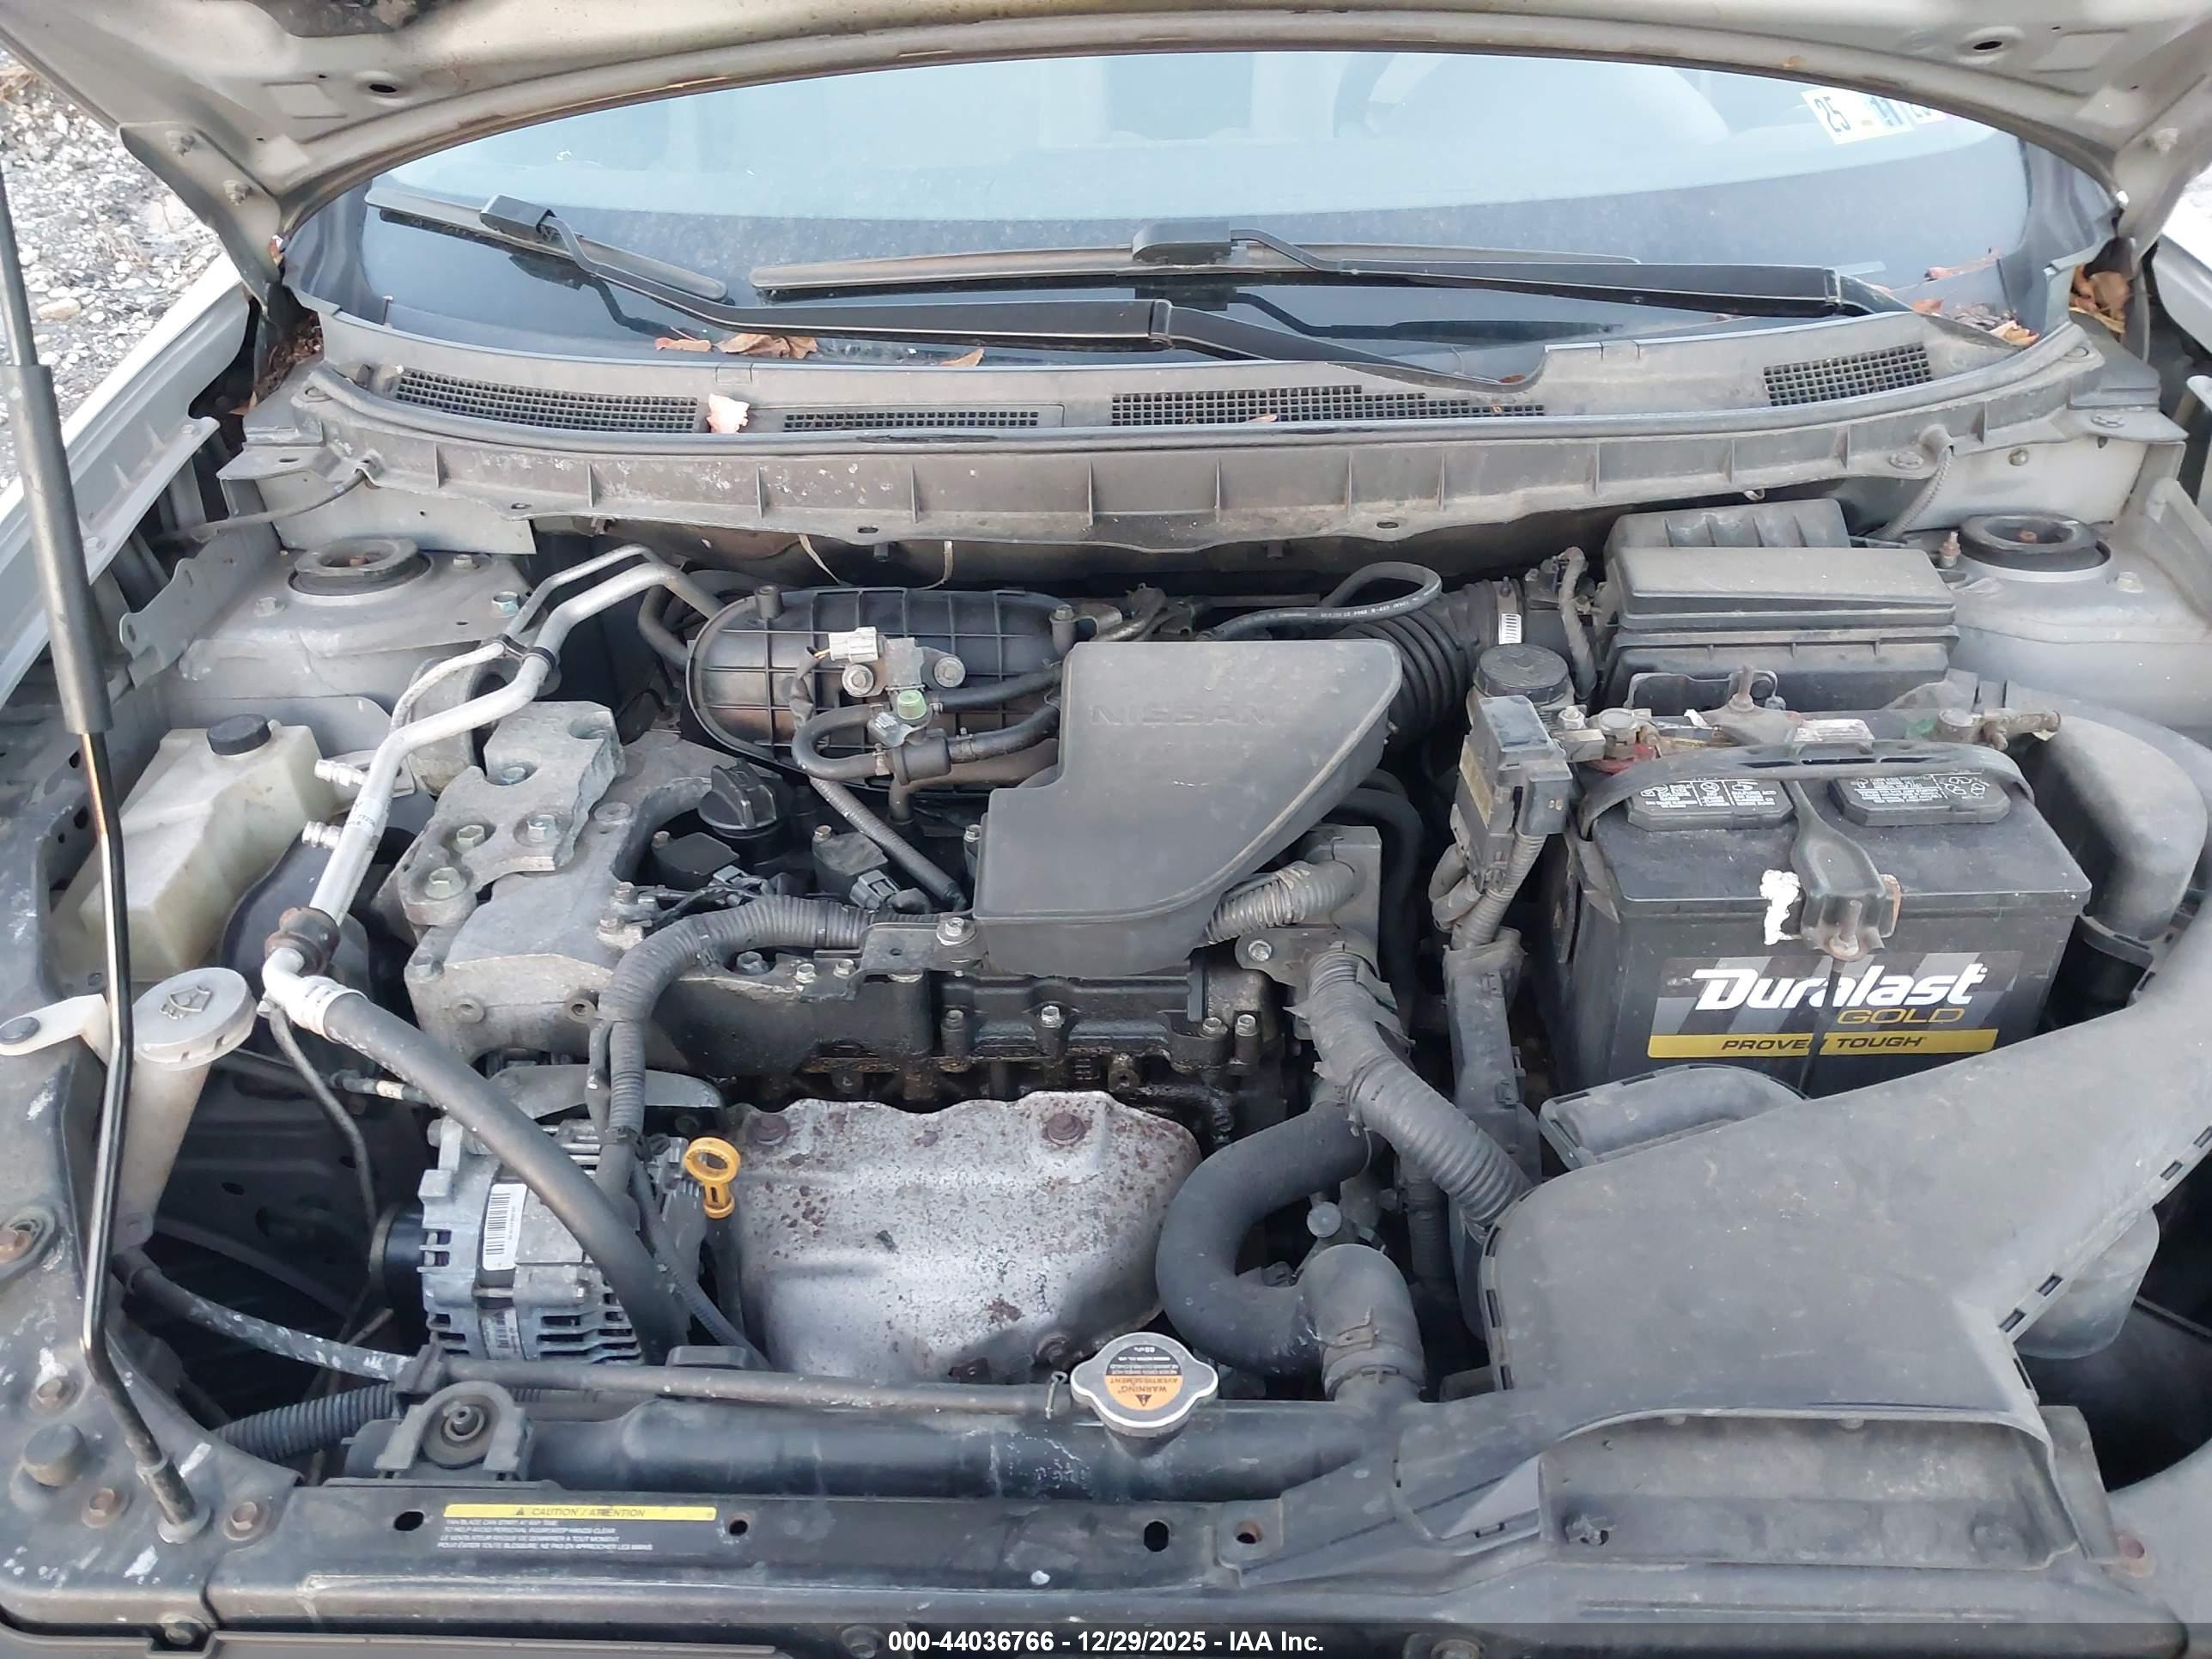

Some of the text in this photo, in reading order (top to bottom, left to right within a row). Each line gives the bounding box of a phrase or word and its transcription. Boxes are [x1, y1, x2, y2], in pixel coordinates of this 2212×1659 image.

[1091, 703, 1276, 726] NISSAN
[1838, 1007, 1966, 1024] GOLD
[1722, 1036, 1925, 1051] PROVE TOUGH
[1121, 1385, 1168, 1394] WARNING
[532, 1507, 578, 1516] CAUTION
